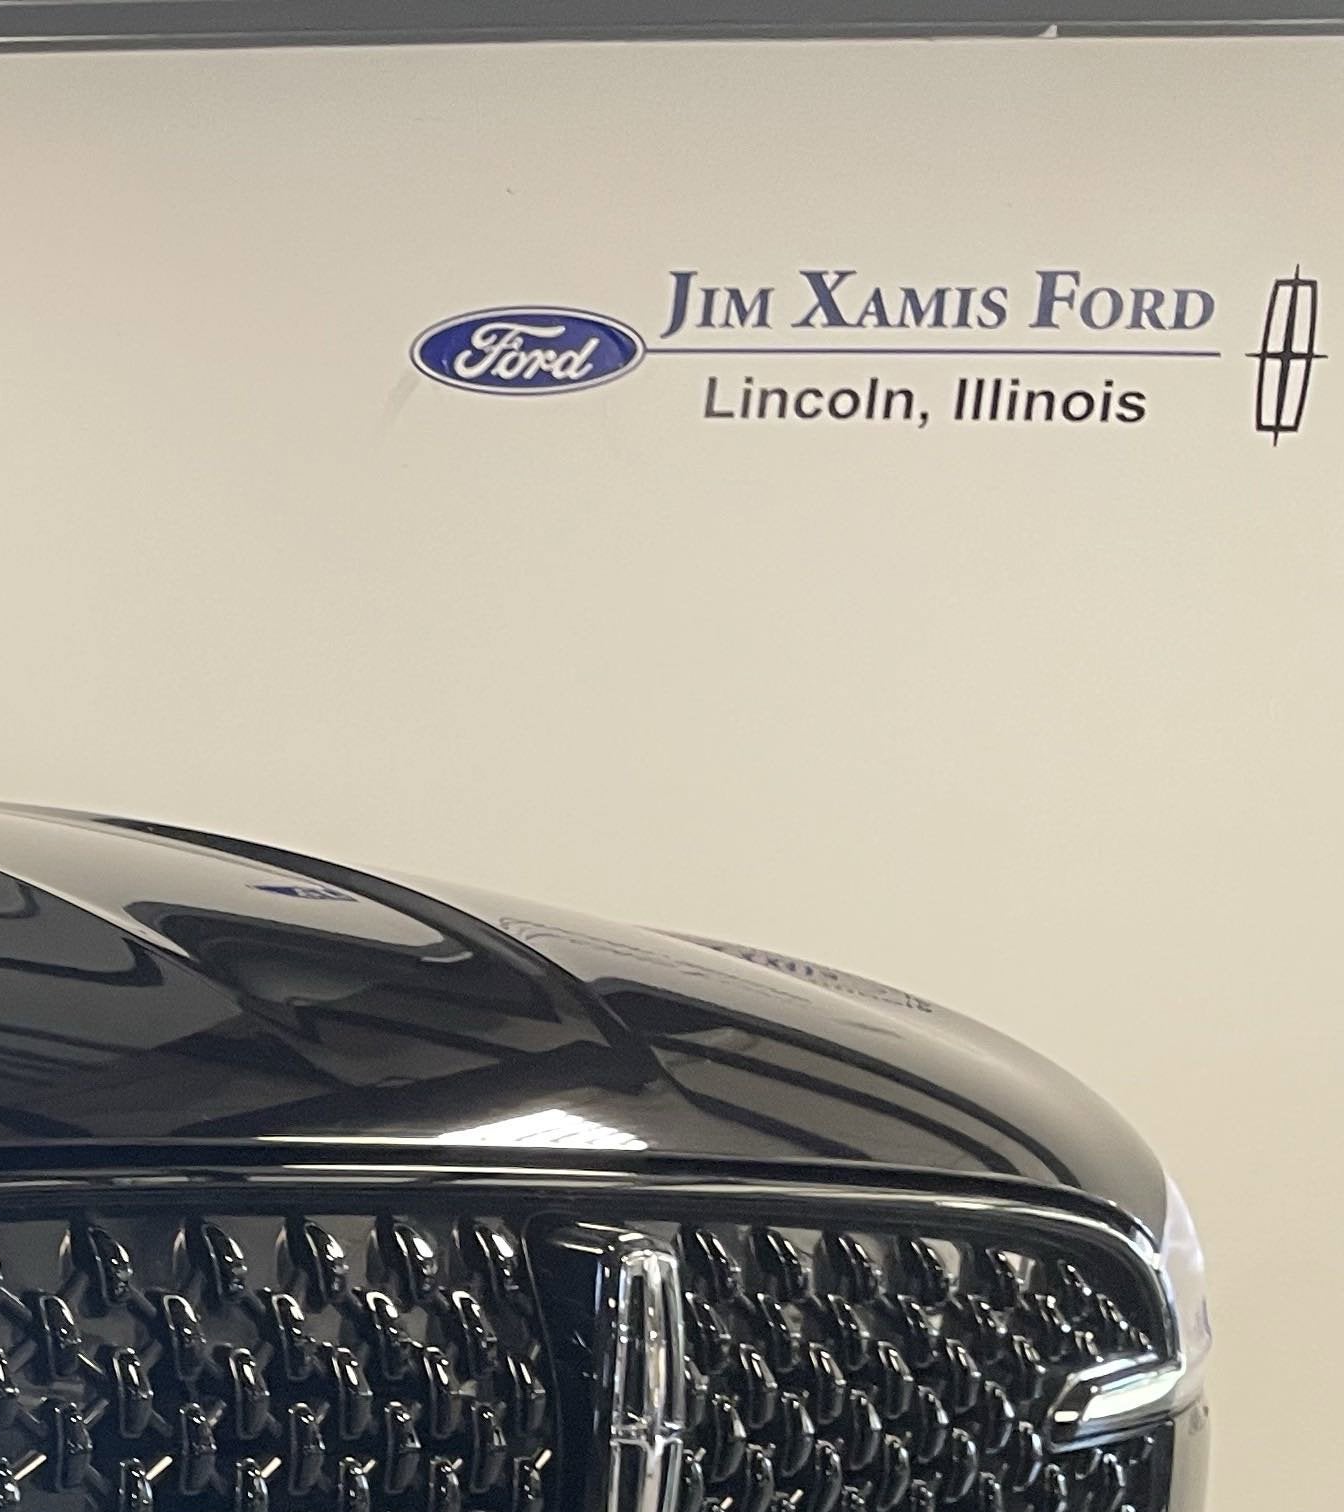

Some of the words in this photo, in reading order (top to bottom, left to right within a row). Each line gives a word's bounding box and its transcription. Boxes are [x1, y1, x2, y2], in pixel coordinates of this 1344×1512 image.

[660, 270, 776, 339] JIM
[790, 270, 1009, 330] XAMIS
[1028, 270, 1215, 331] FORD
[453, 321, 601, 380] Ford
[702, 376, 929, 430] Lincoln,
[952, 377, 1148, 423] Illinois
